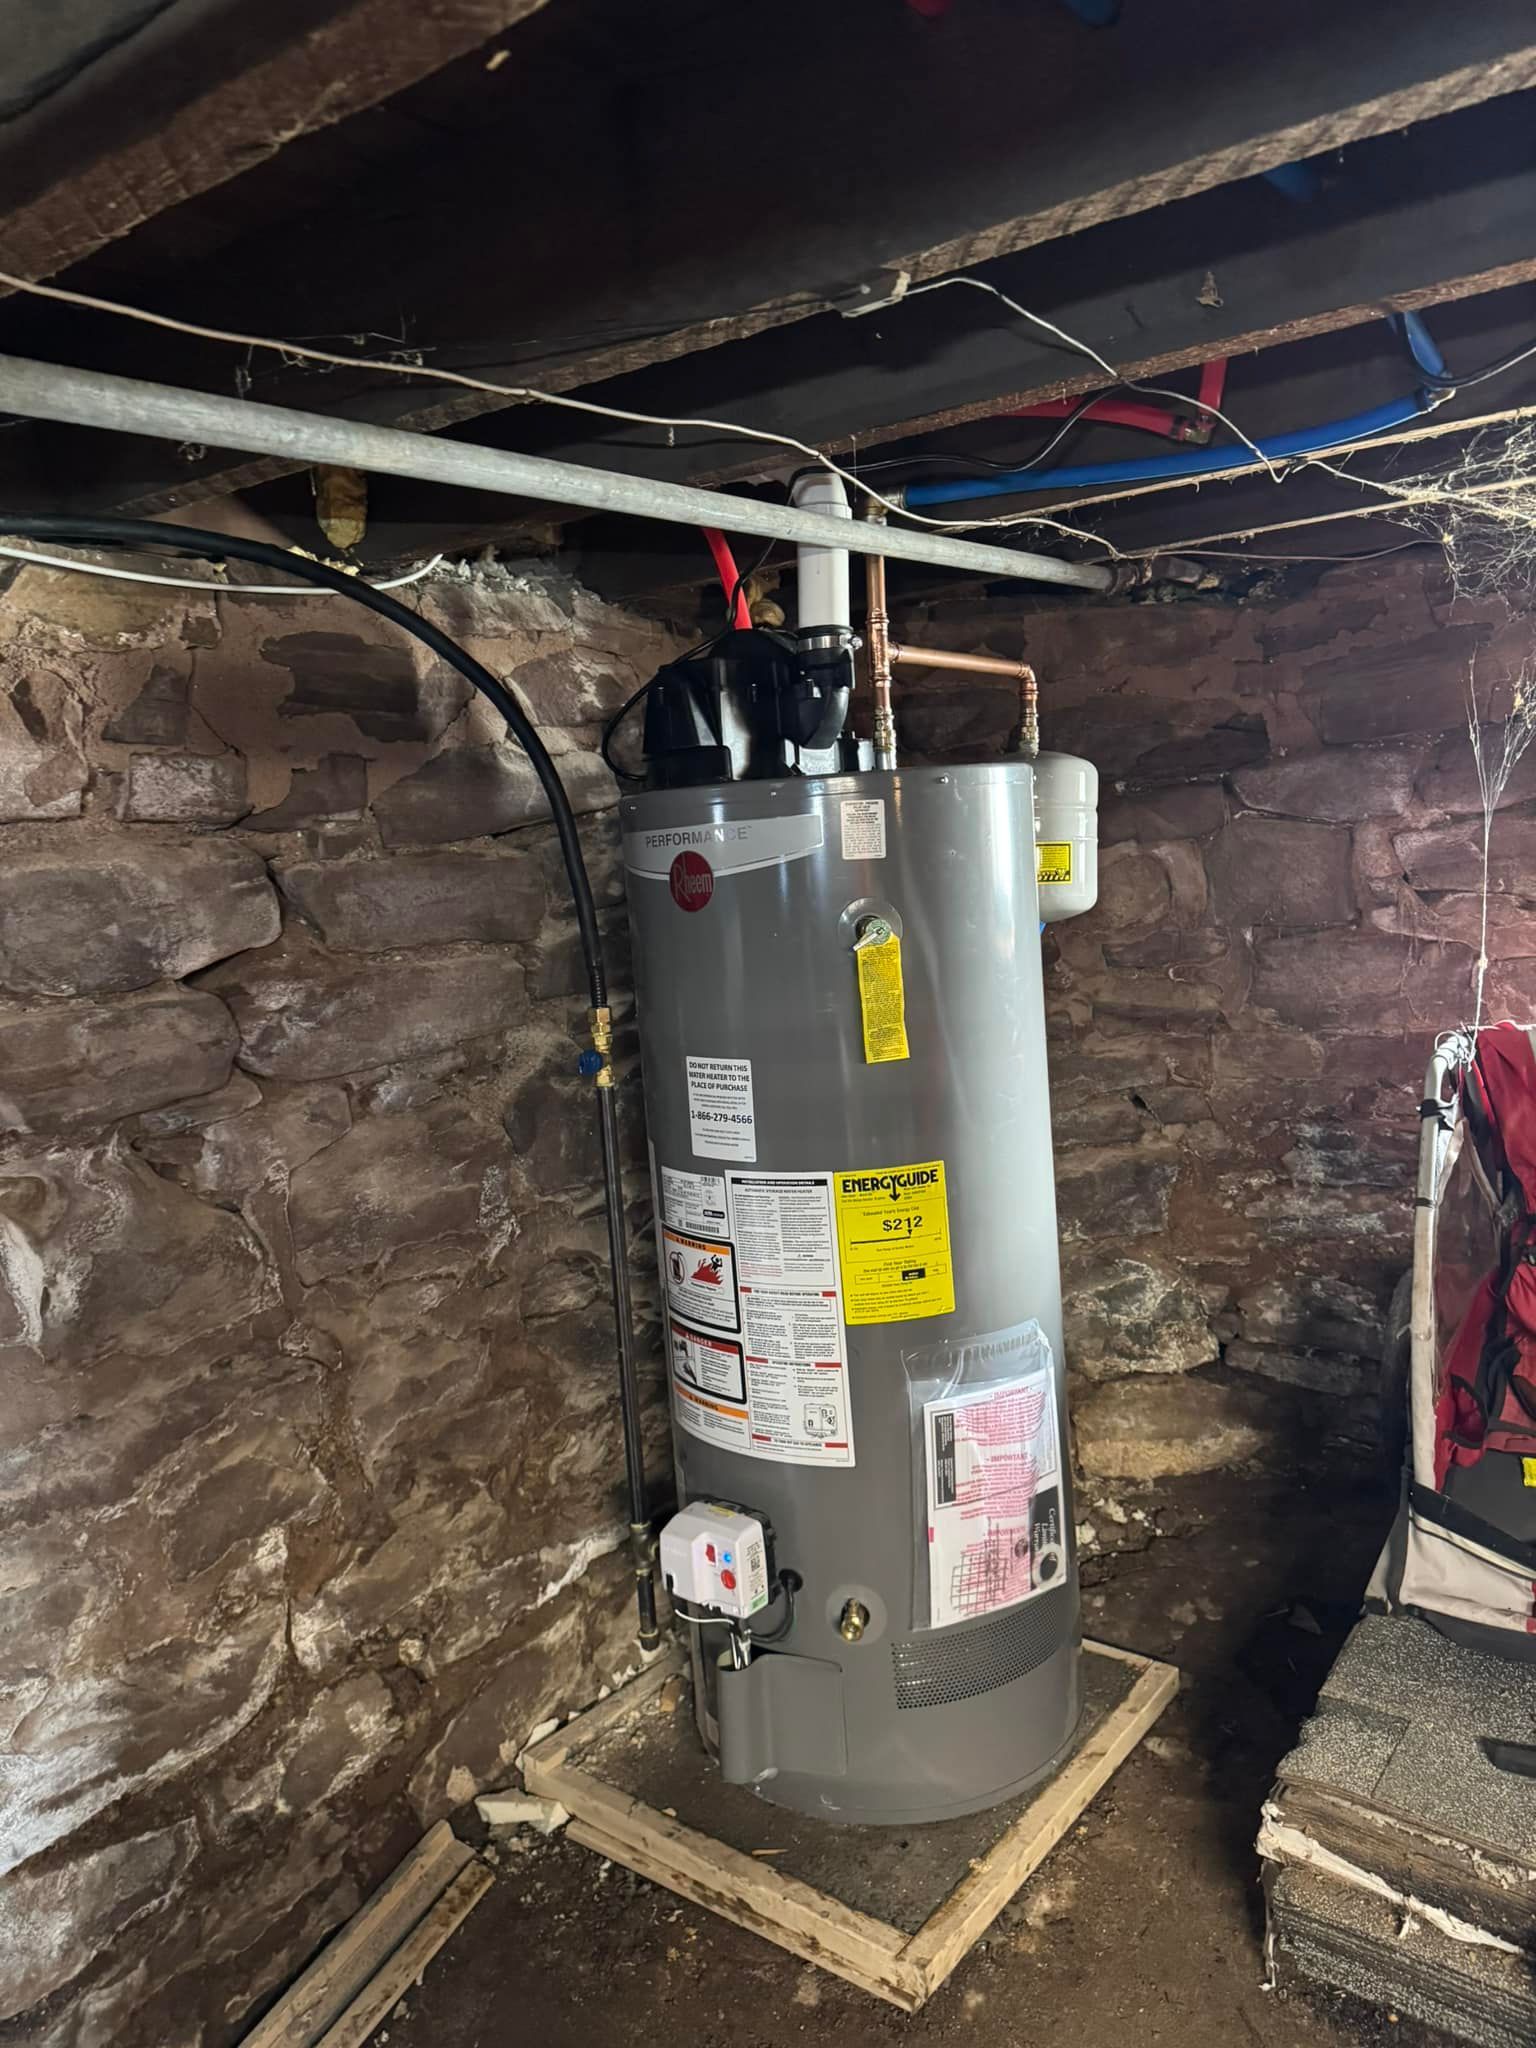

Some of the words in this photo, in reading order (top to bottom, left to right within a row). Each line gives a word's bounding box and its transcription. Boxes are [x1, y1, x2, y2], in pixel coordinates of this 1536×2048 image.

[673, 853, 713, 903] Rheem
[710, 1064, 733, 1072] RETURN
[689, 1071, 706, 1079] WATER
[706, 1073, 728, 1081] HEATER
[691, 1081, 707, 1089] PLACE
[707, 1082, 715, 1090] OF
[716, 1084, 748, 1092] PURCHASE
[882, 1215, 923, 1232] $212
